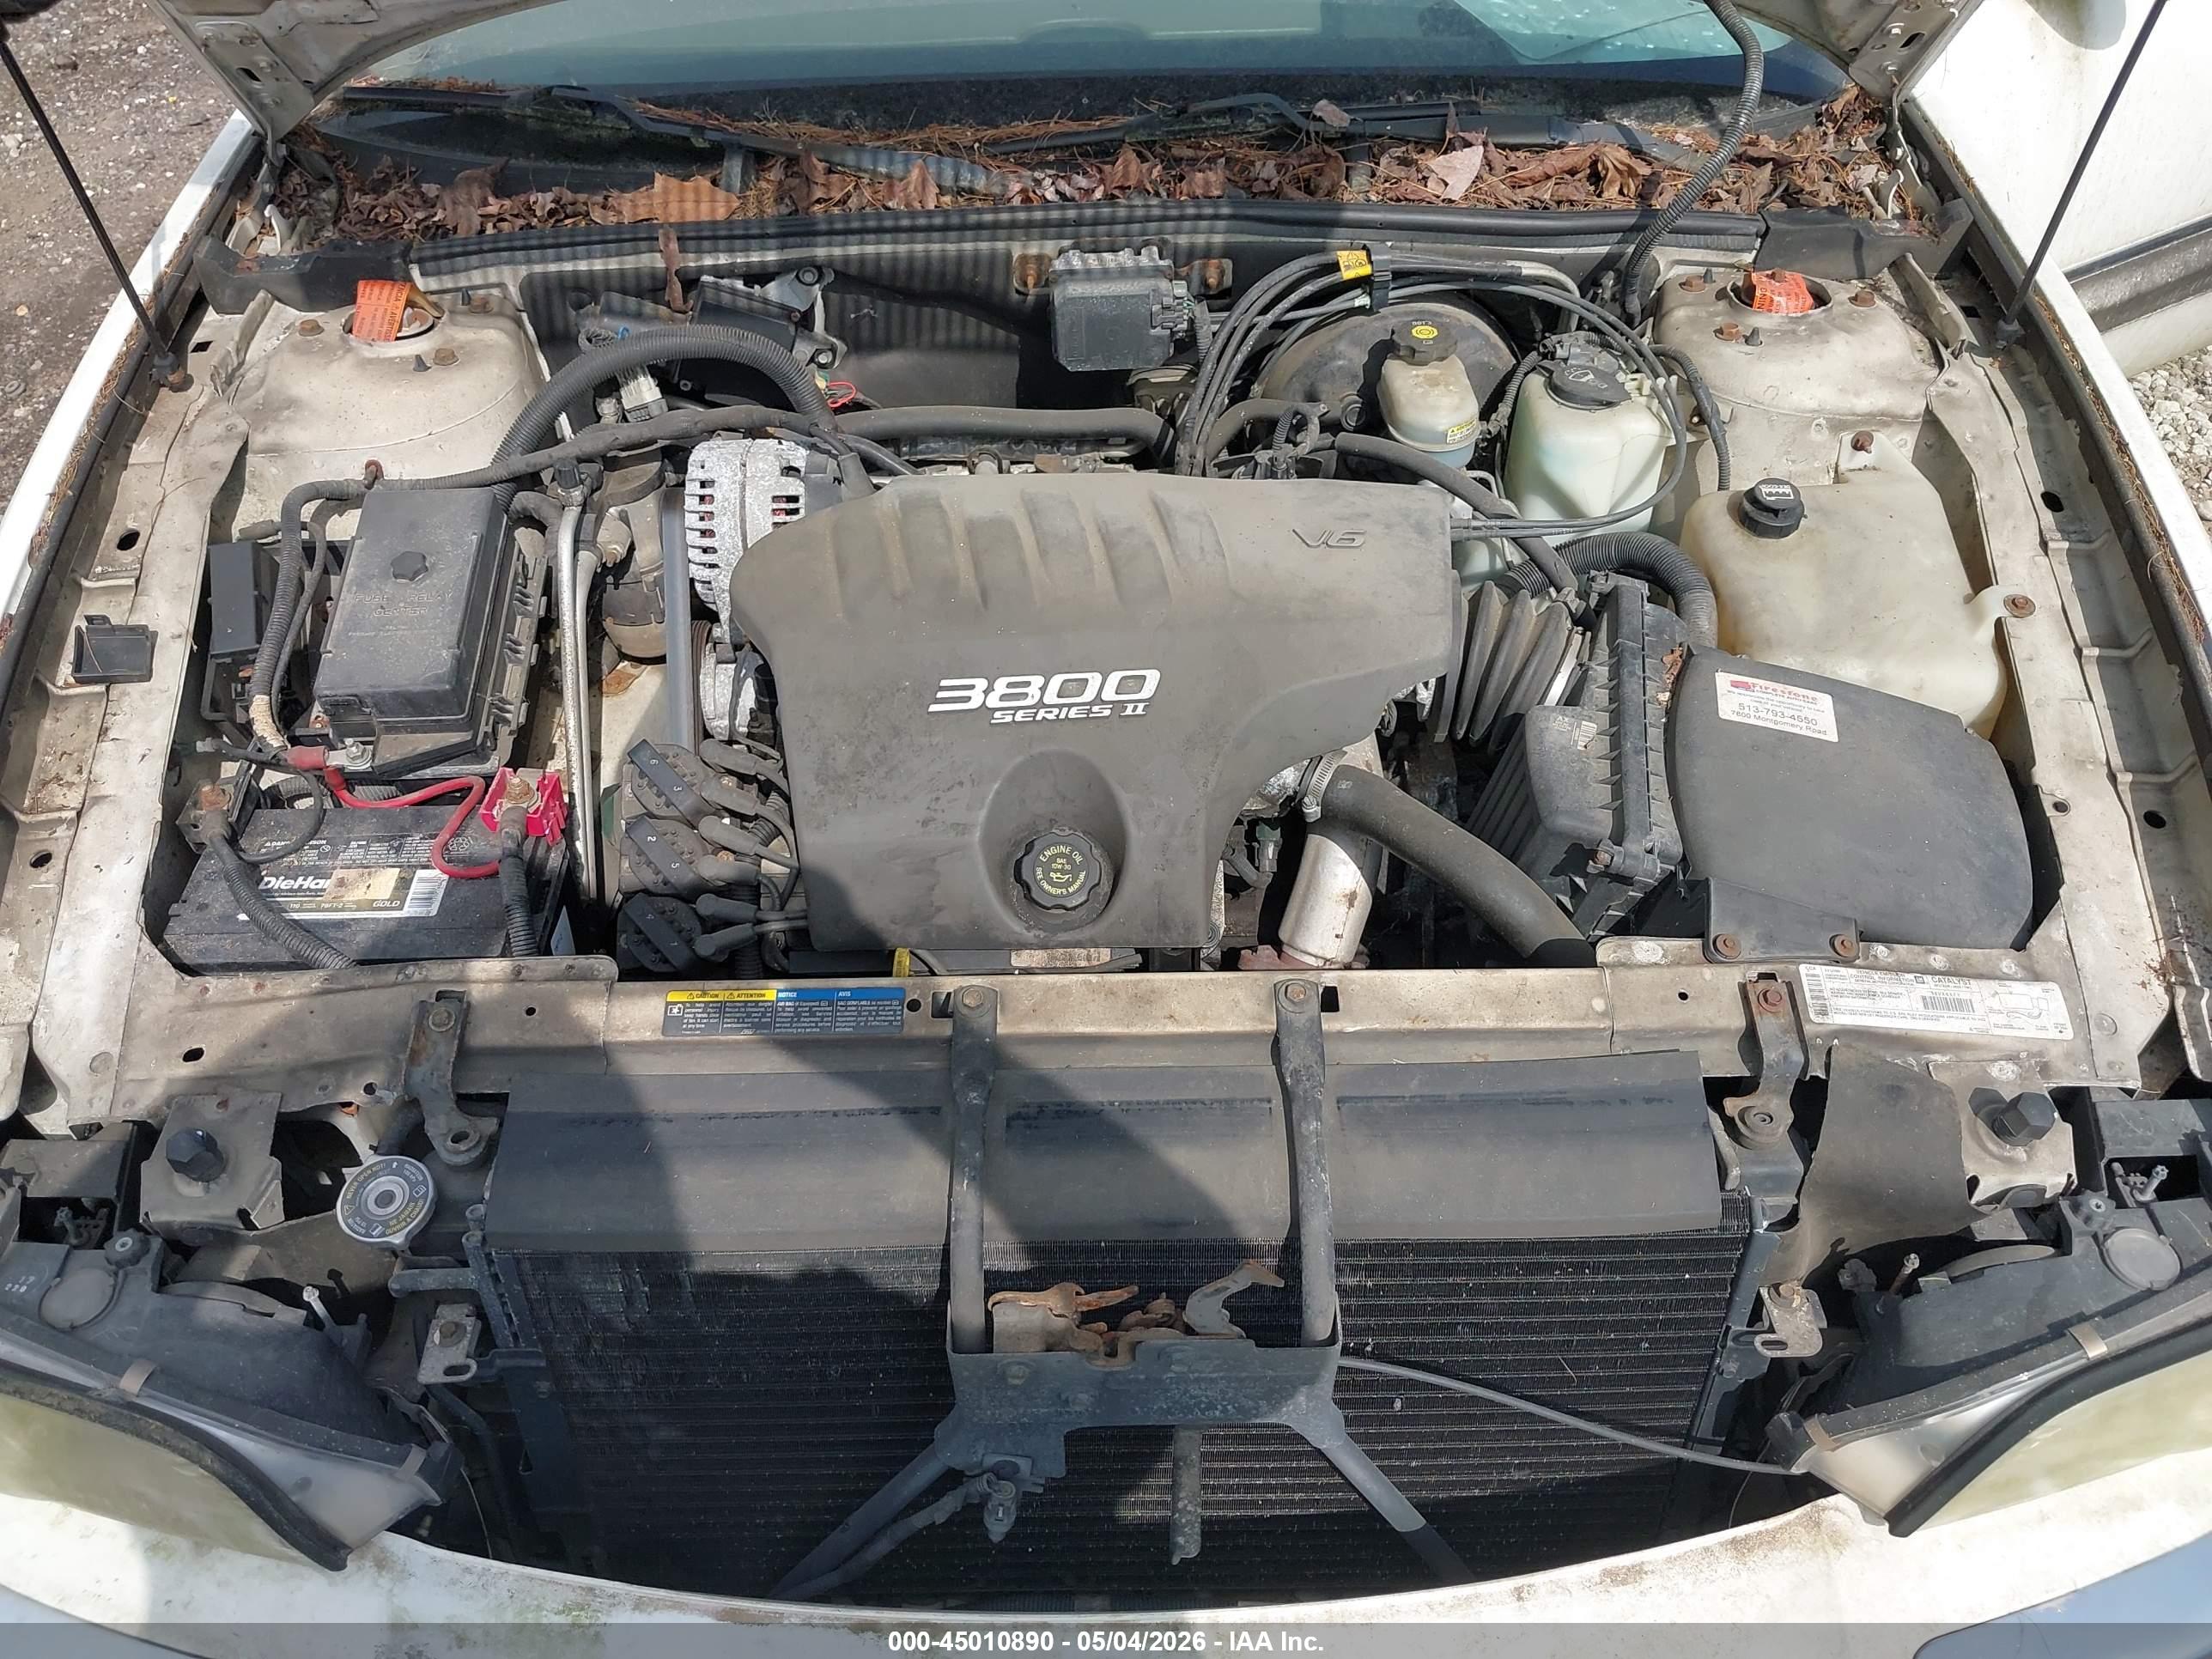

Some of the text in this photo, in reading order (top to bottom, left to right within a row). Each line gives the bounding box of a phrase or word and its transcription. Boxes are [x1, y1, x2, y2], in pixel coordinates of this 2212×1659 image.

[1291, 529, 1365, 549] V6
[354, 589, 453, 603] FUSE RELAY
[374, 605, 428, 617] CENTER
[927, 669, 1161, 713] 3800
[1751, 682, 1819, 702] Firestone
[990, 702, 1150, 724] SERIES II
[1753, 714, 1803, 731] Montgomery
[1805, 726, 1827, 736] Road
[1039, 845, 1084, 866] ENGINE OIL
[258, 875, 331, 890] DieHar
[1040, 879, 1067, 895] OWNER'S
[1067, 870, 1086, 894] MANUAL
[1931, 976, 1972, 986] CATALYST
